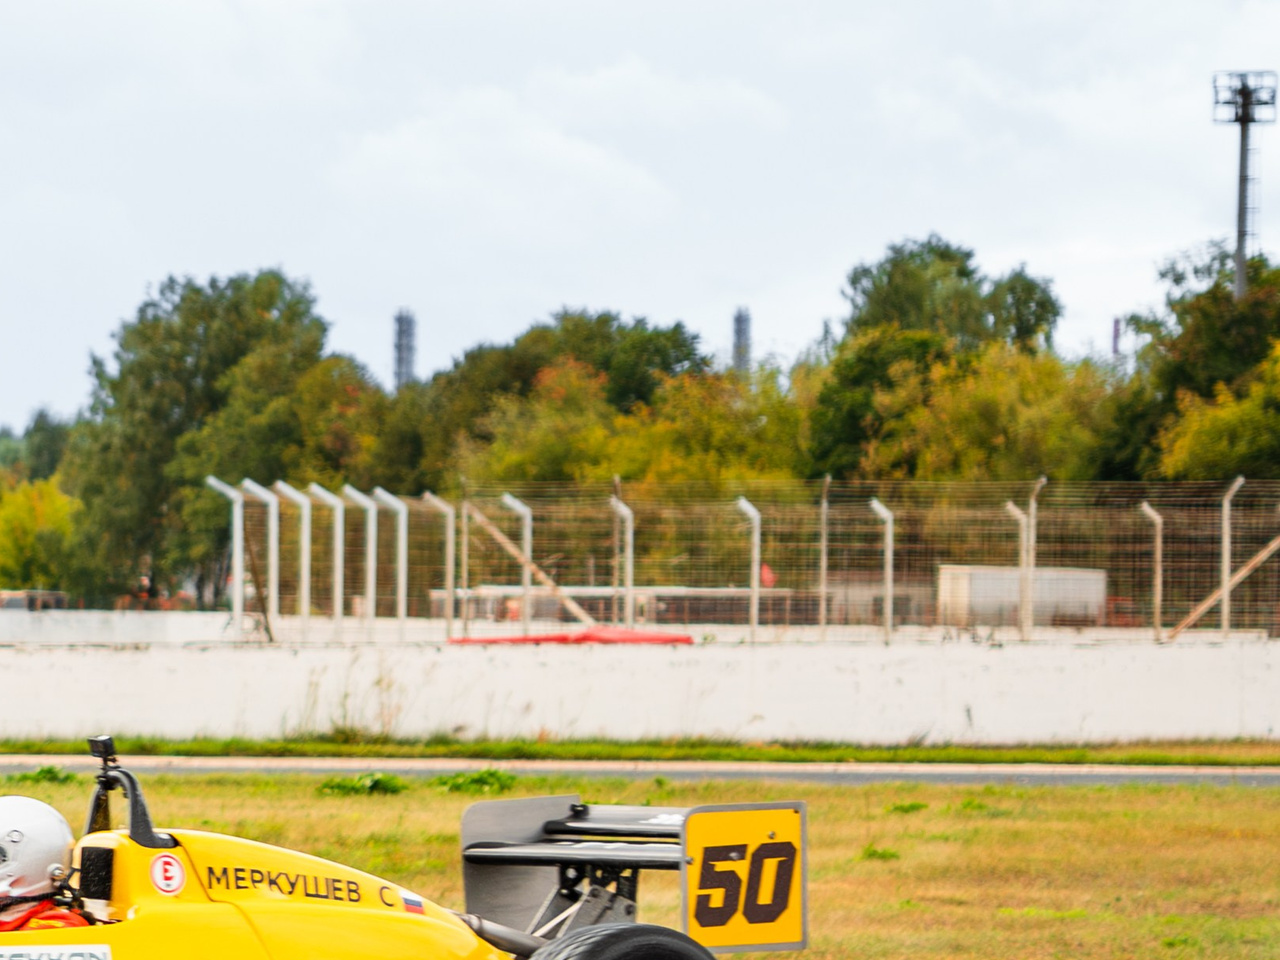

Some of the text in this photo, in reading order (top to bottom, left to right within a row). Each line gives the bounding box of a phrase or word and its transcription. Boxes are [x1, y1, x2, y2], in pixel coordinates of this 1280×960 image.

[207, 866, 395, 907] МЕРКУШЕВ С
[695, 841, 797, 928] 50
